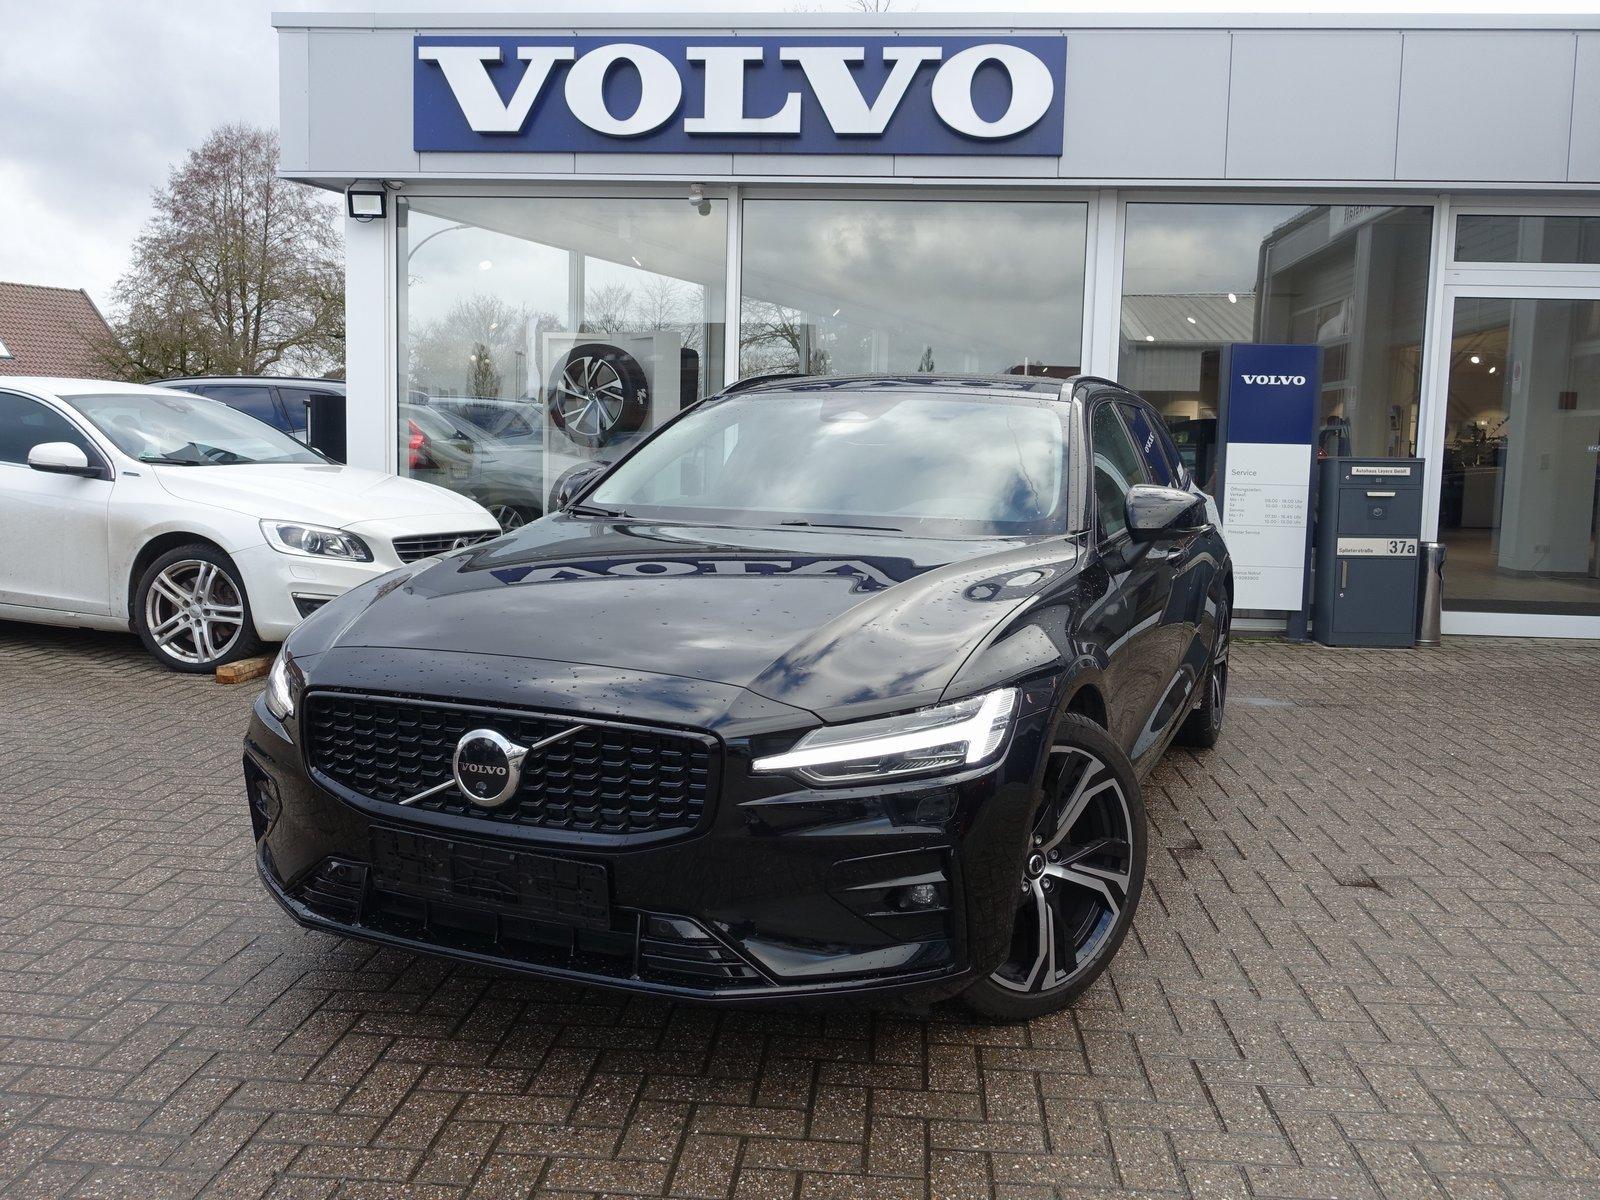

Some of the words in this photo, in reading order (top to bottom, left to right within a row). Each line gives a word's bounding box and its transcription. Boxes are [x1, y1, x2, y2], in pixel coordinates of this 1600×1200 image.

[417, 43, 1055, 138] VOLVO
[1241, 374, 1306, 386] VOLVO
[1231, 469, 1257, 477] Service
[1388, 540, 1416, 554] 37a
[459, 761, 507, 776] VOLVO
